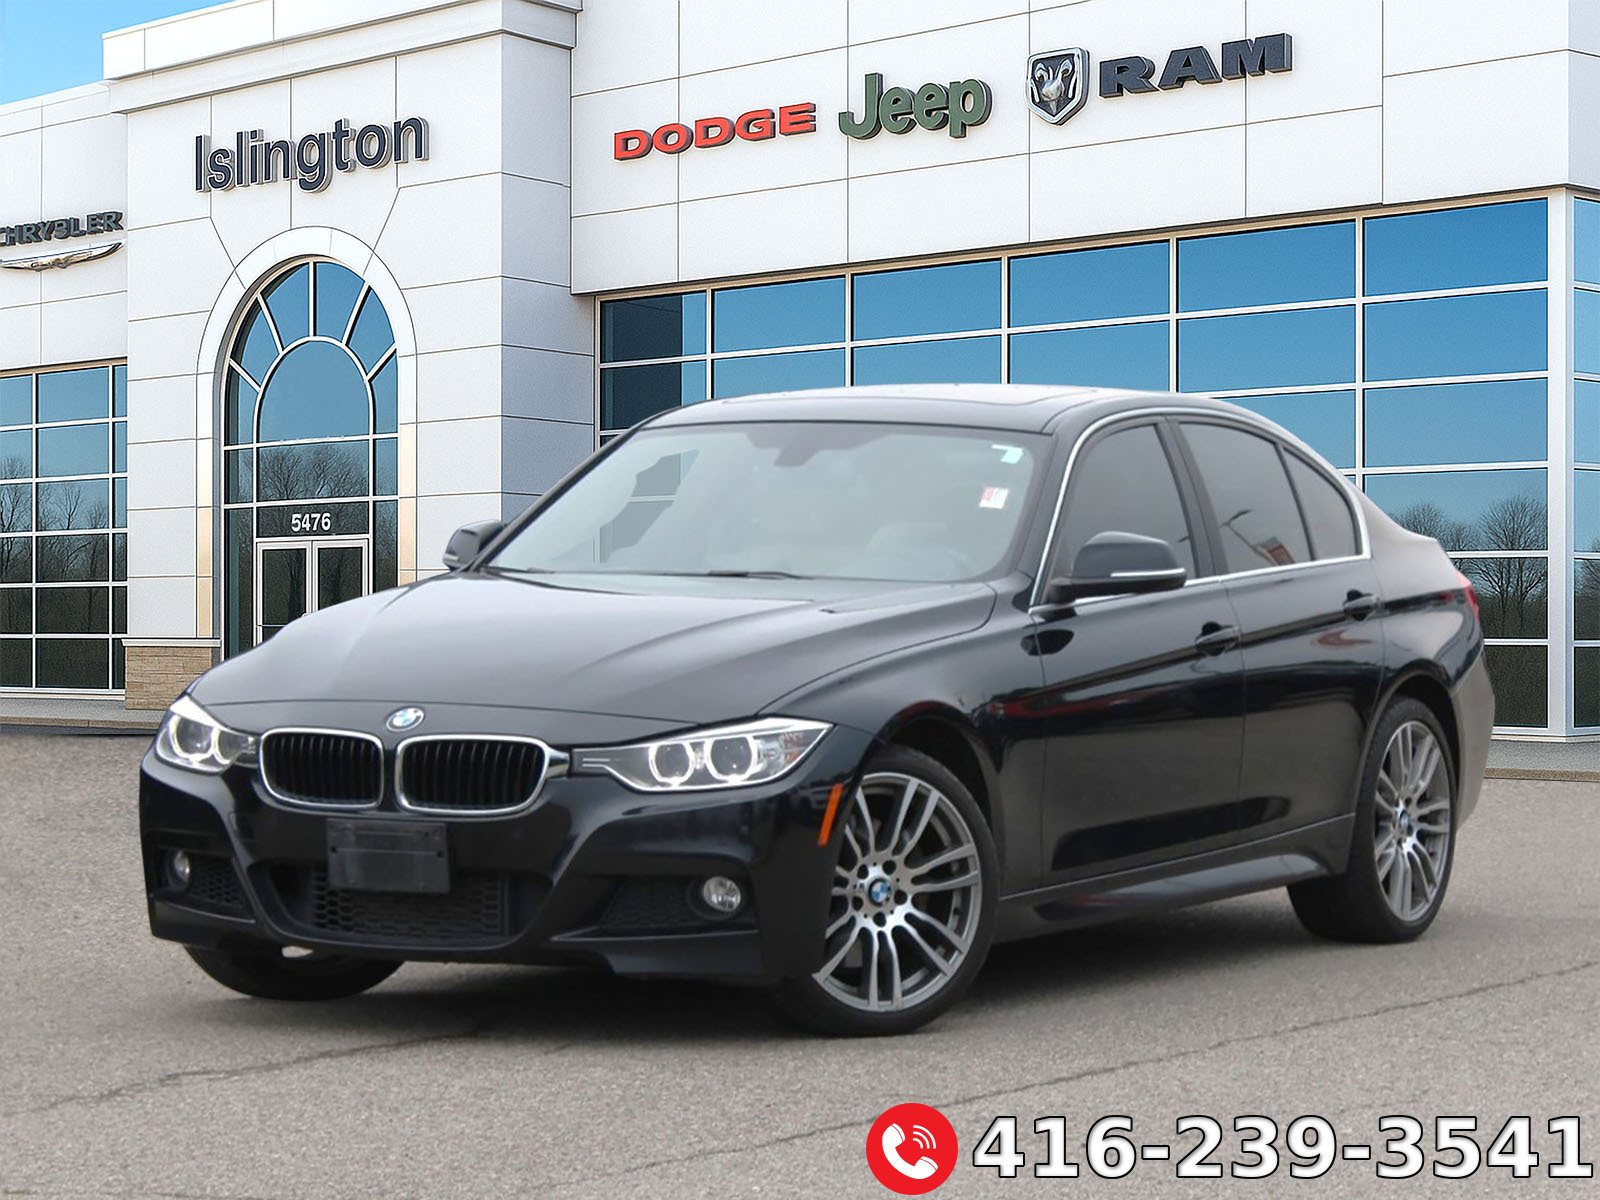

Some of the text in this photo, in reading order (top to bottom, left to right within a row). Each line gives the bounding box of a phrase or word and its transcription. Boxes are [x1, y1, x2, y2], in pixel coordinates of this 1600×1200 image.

[614, 33, 1292, 161] DODGE Jeep RAM
[194, 115, 430, 193] Islington
[291, 512, 331, 532] 5476
